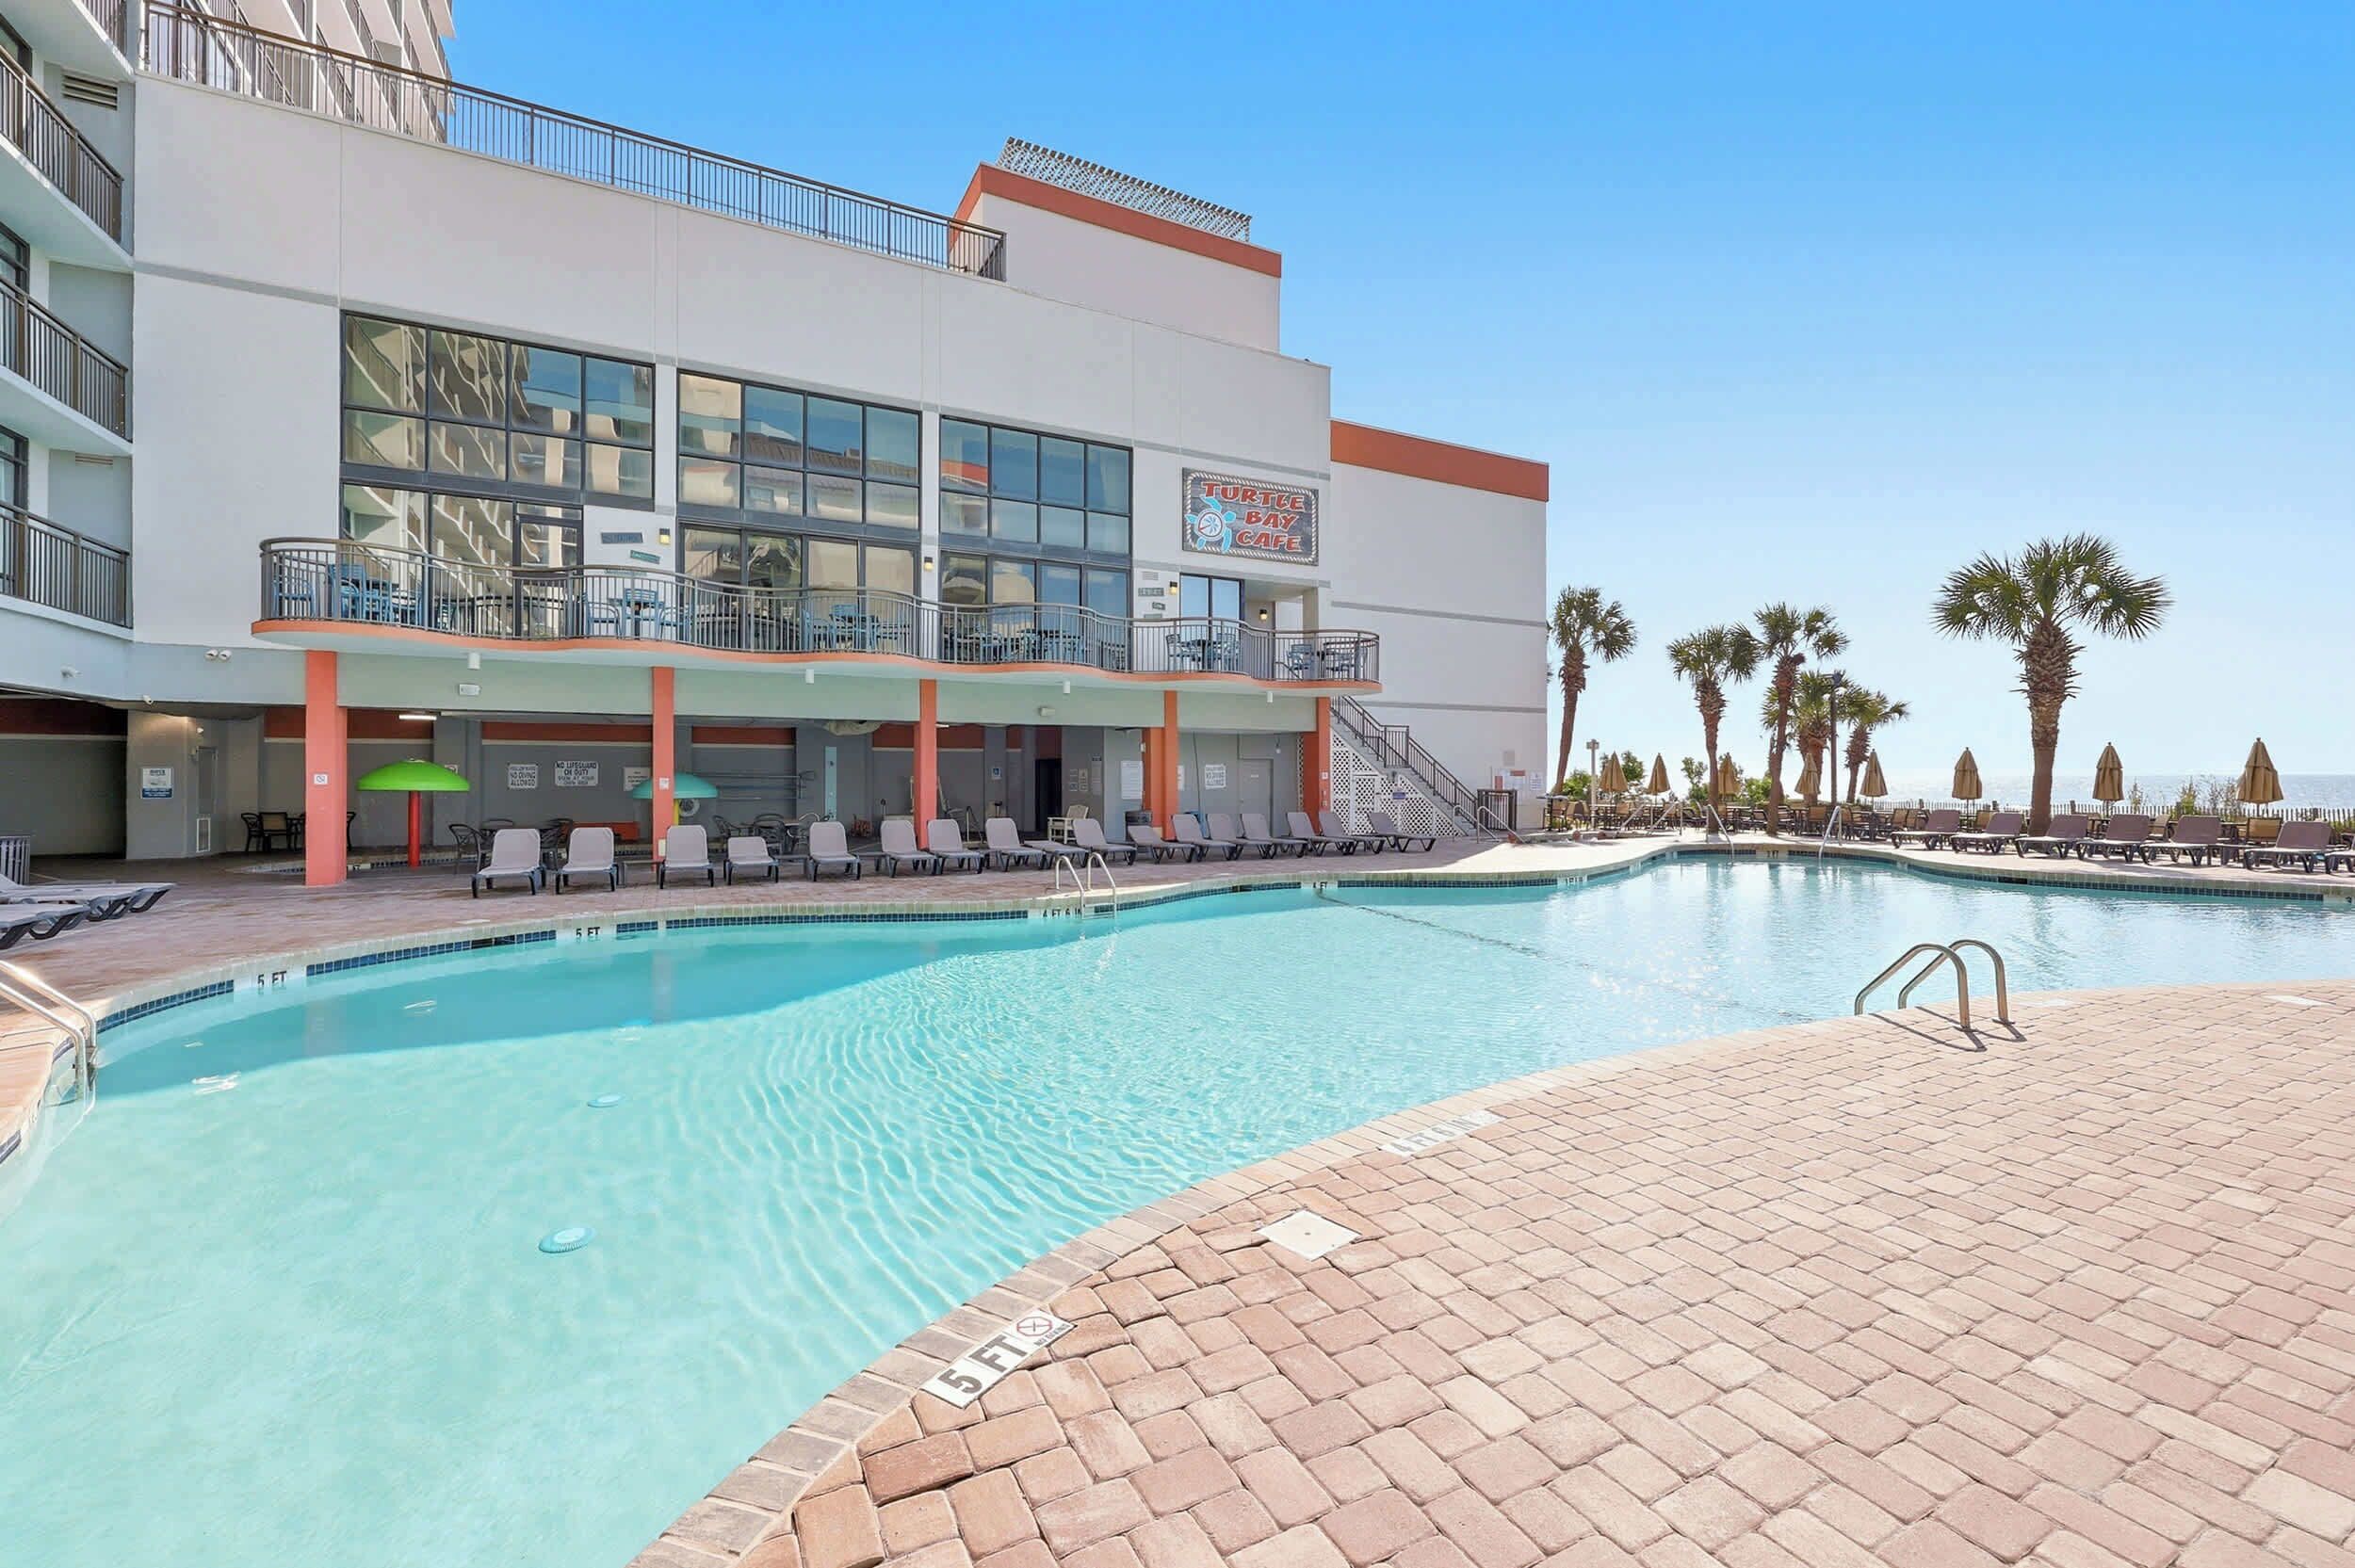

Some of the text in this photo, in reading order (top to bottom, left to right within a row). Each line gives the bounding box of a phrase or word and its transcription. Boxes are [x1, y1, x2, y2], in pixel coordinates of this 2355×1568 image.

[1201, 481, 1305, 511] TURTLE
[1244, 509, 1299, 530] BAY
[1236, 529, 1302, 552] CAFE
[577, 927, 601, 937] 5 FT
[257, 970, 286, 986] 5 FT
[1405, 1132, 1439, 1146] FT
[1432, 1127, 1455, 1137] 6
[937, 1334, 1028, 1394] 5 FT
